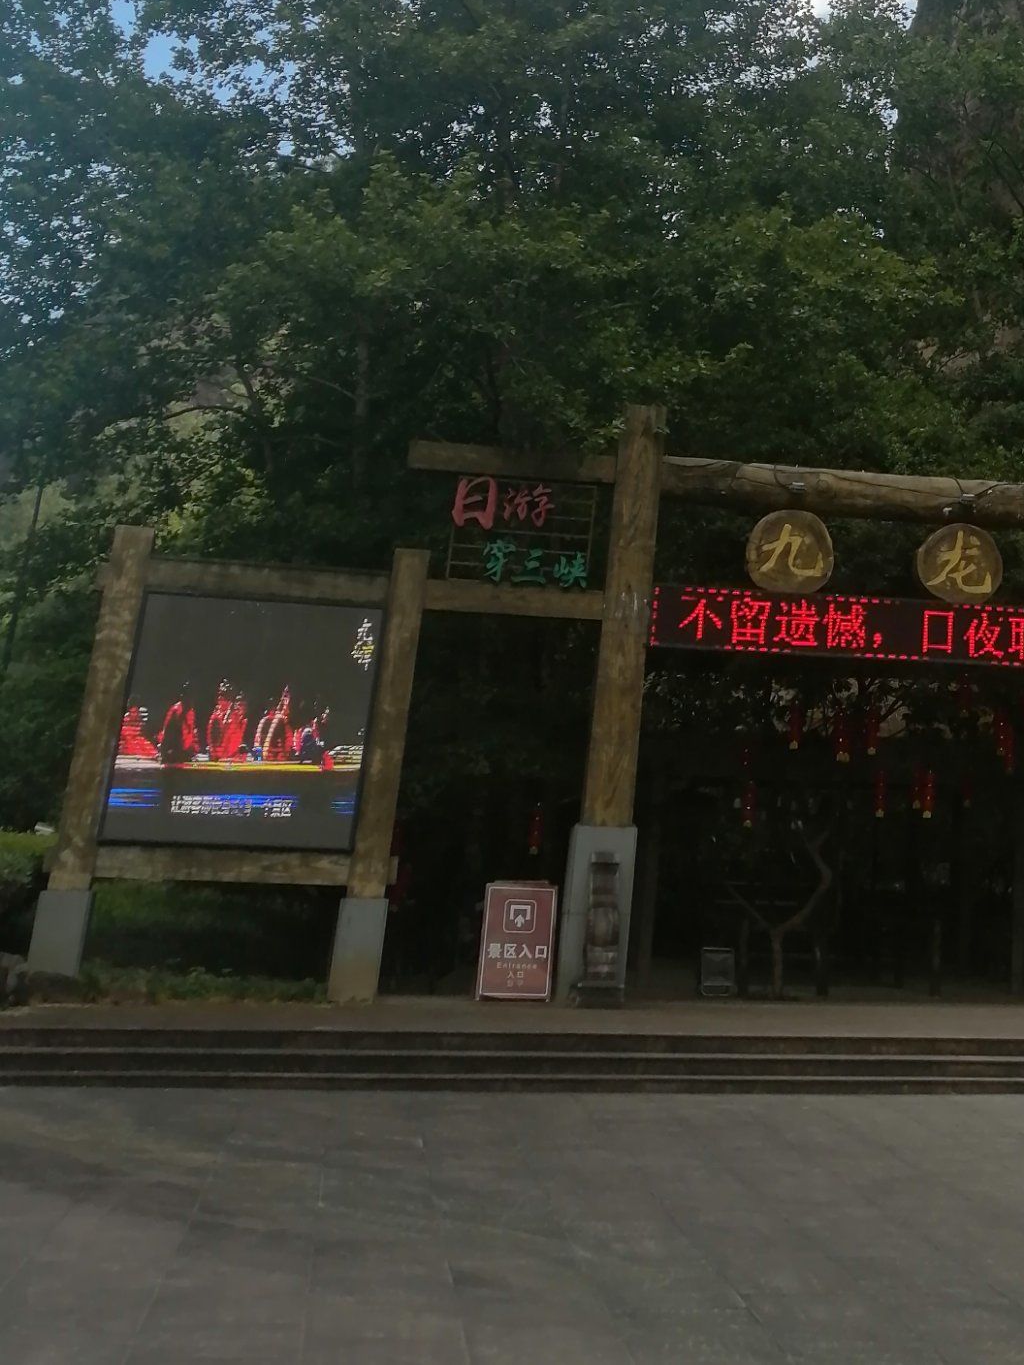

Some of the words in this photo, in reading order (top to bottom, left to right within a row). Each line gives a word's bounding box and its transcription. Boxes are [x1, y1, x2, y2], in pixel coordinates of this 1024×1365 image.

[452, 477, 555, 530] 日游
[482, 540, 588, 588] 穿三峡
[487, 943, 548, 959] 景区入口
